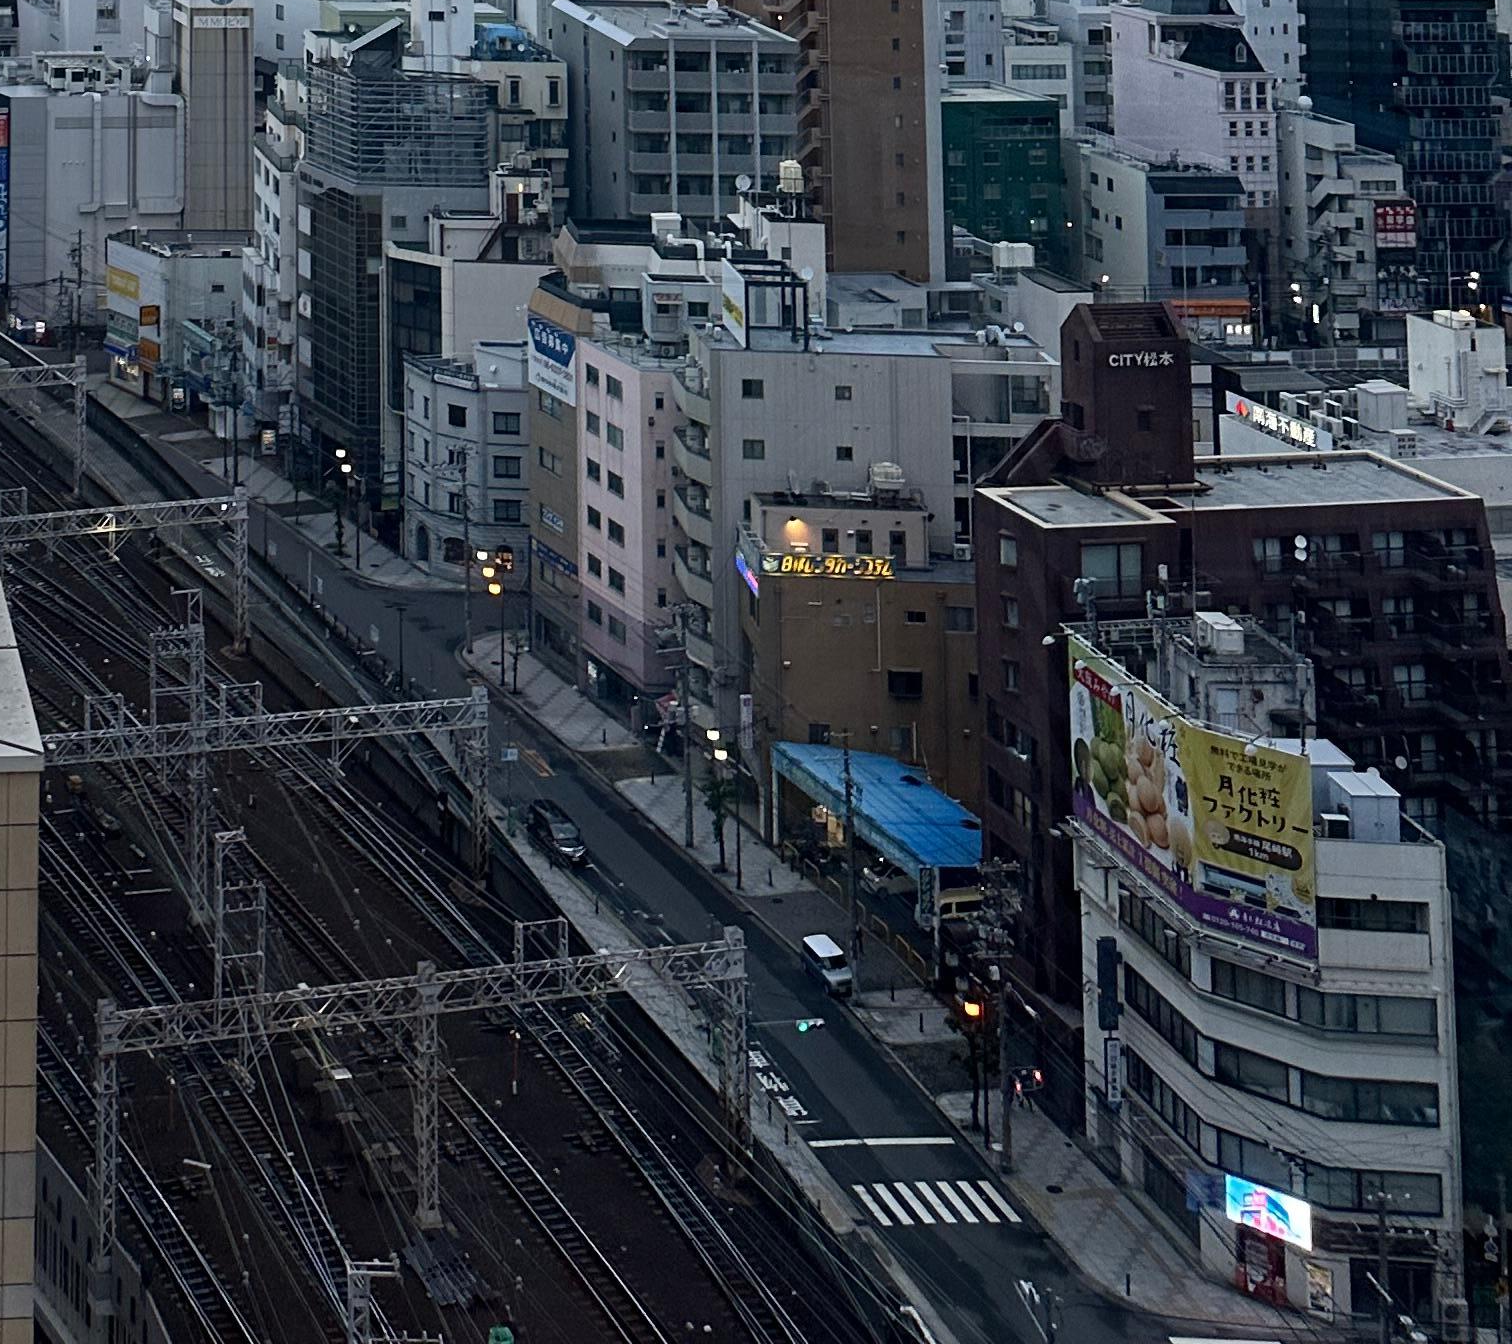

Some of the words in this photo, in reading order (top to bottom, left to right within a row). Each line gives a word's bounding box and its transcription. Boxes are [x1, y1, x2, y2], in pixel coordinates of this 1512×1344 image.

[1218, 775, 1281, 809] 月化粧
[1202, 796, 1309, 834] ファクトリー
